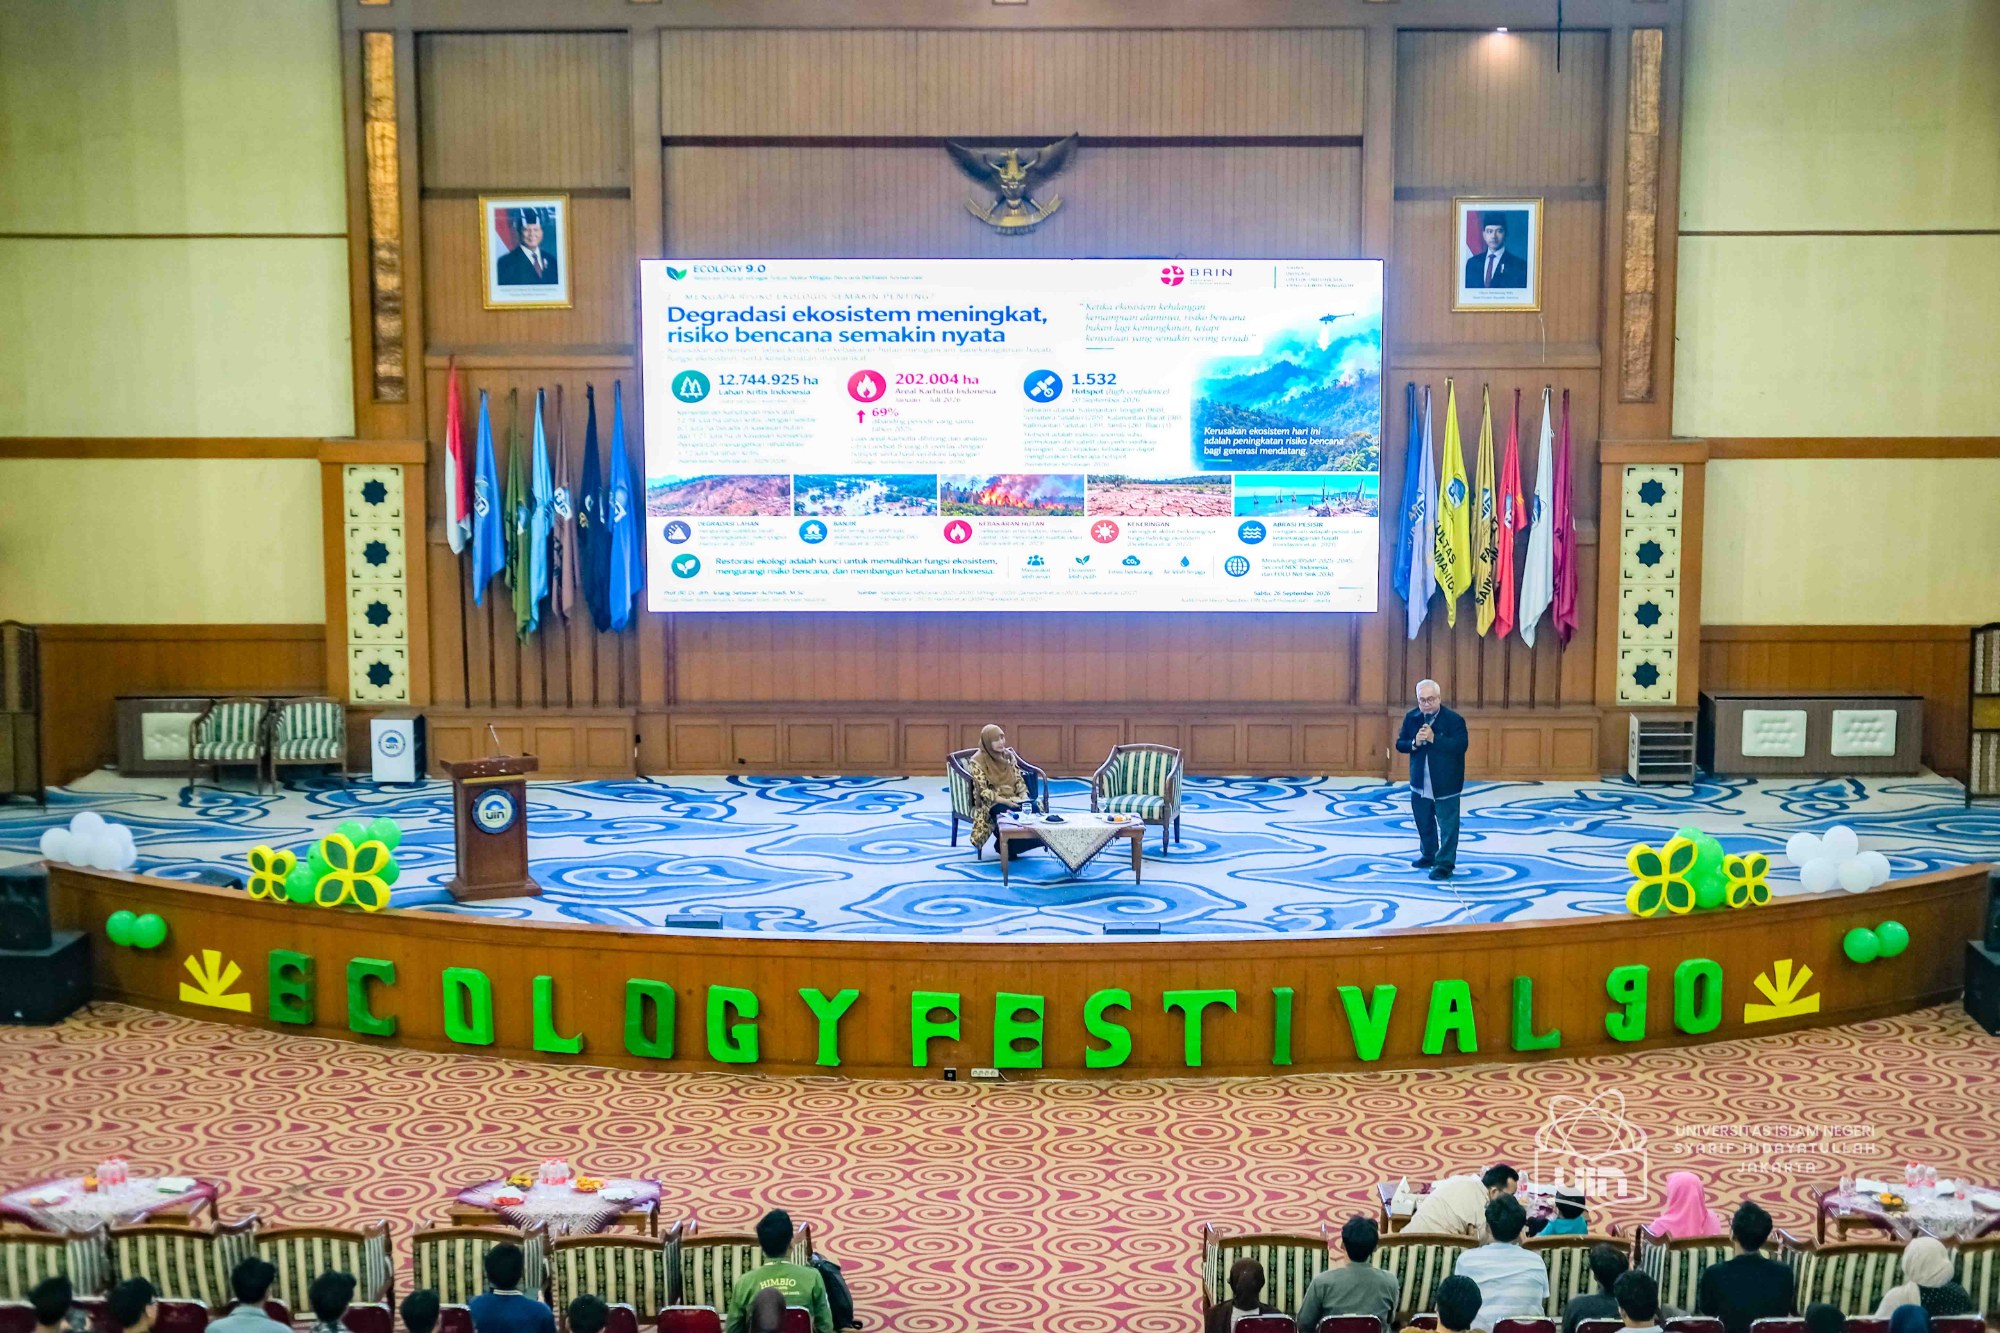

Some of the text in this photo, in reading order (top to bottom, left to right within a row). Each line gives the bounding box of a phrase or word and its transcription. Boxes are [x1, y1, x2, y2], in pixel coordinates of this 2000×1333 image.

[745, 264, 766, 273] 9.0
[668, 306, 1047, 326] Degradasi ekosistem meningkat,
[1114, 323, 1131, 332] lagi
[668, 325, 1005, 346] risiko bencana semakin nyata
[1193, 334, 1219, 343] sering
[719, 374, 818, 385] 12.744.925 ha
[896, 374, 979, 384] 202.004 ha
[1072, 373, 1116, 385] 1.532
[872, 408, 899, 416] 69%
[1233, 438, 1283, 446] peningkatan
[1204, 447, 1221, 456] bagi
[1260, 448, 1308, 456] mendatang.
[767, 566, 790, 574] risiko
[268, 948, 860, 1067] ECOLOGY
[911, 975, 1561, 1068] FESTIVAL
[760, 1278, 796, 1289] HIMBIO
